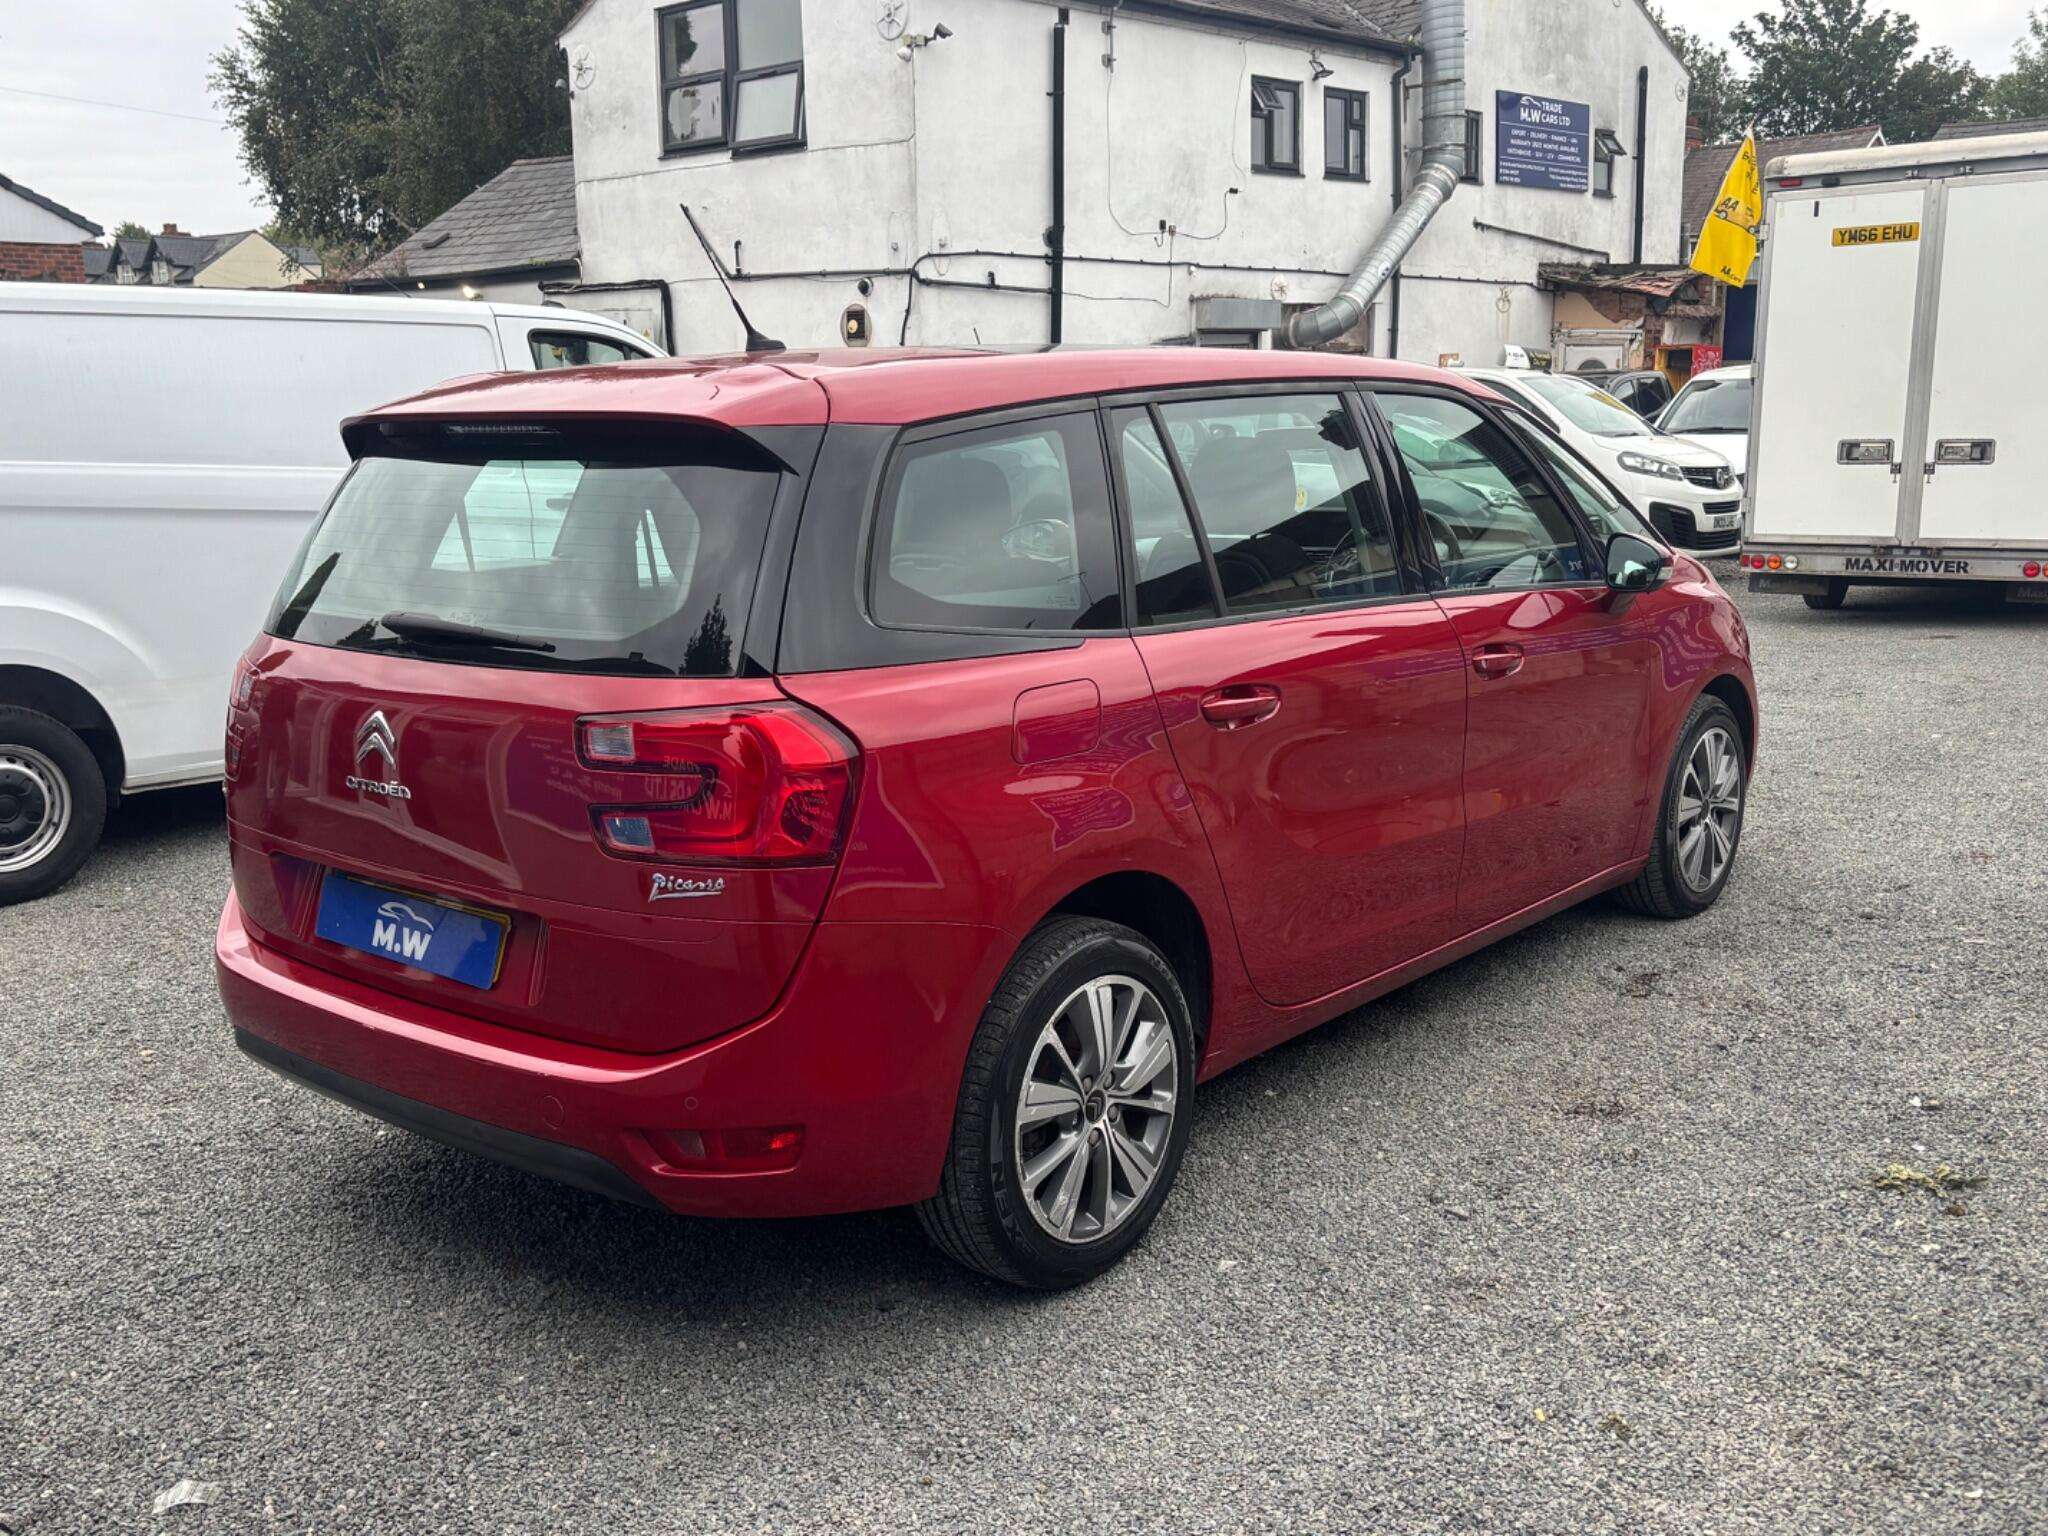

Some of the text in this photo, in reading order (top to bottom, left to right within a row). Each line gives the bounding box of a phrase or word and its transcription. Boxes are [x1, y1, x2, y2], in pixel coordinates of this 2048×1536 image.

[1520, 107, 1571, 126] M.W CARS LTD
[1541, 101, 1563, 114] TRADE
[1838, 224, 1913, 244] YM66 EHU
[1845, 557, 1969, 574] MAXI MOVER
[648, 872, 725, 904] Picasso
[372, 918, 432, 961] M.W
